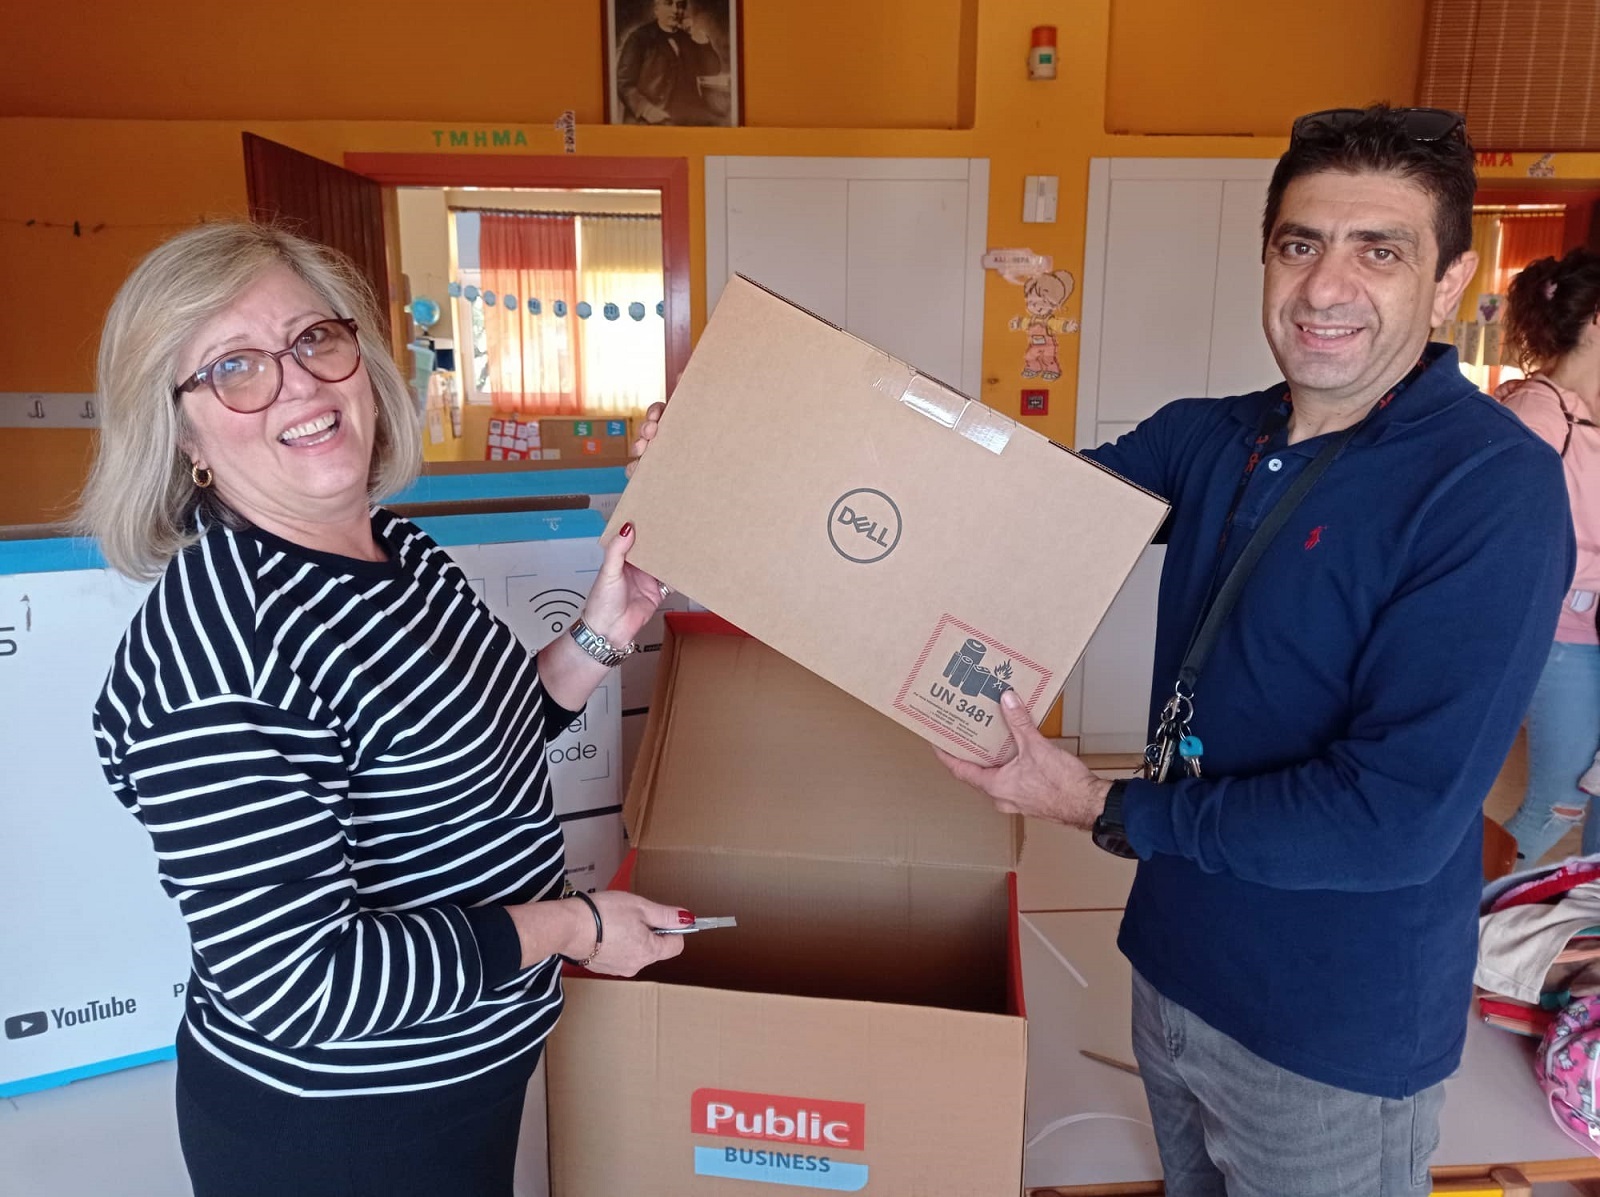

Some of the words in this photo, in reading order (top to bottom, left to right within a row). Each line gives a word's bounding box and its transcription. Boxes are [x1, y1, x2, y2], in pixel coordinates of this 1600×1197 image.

[1479, 152, 1514, 168] ΜΑ
[837, 505, 889, 548] DELL
[929, 682, 956, 706] UN
[956, 698, 994, 728] 3481
[567, 712, 588, 733] el
[549, 741, 598, 764] ode
[51, 996, 138, 1029] YouTube
[706, 1102, 851, 1146] Public
[724, 1146, 832, 1173] BUSINESS
